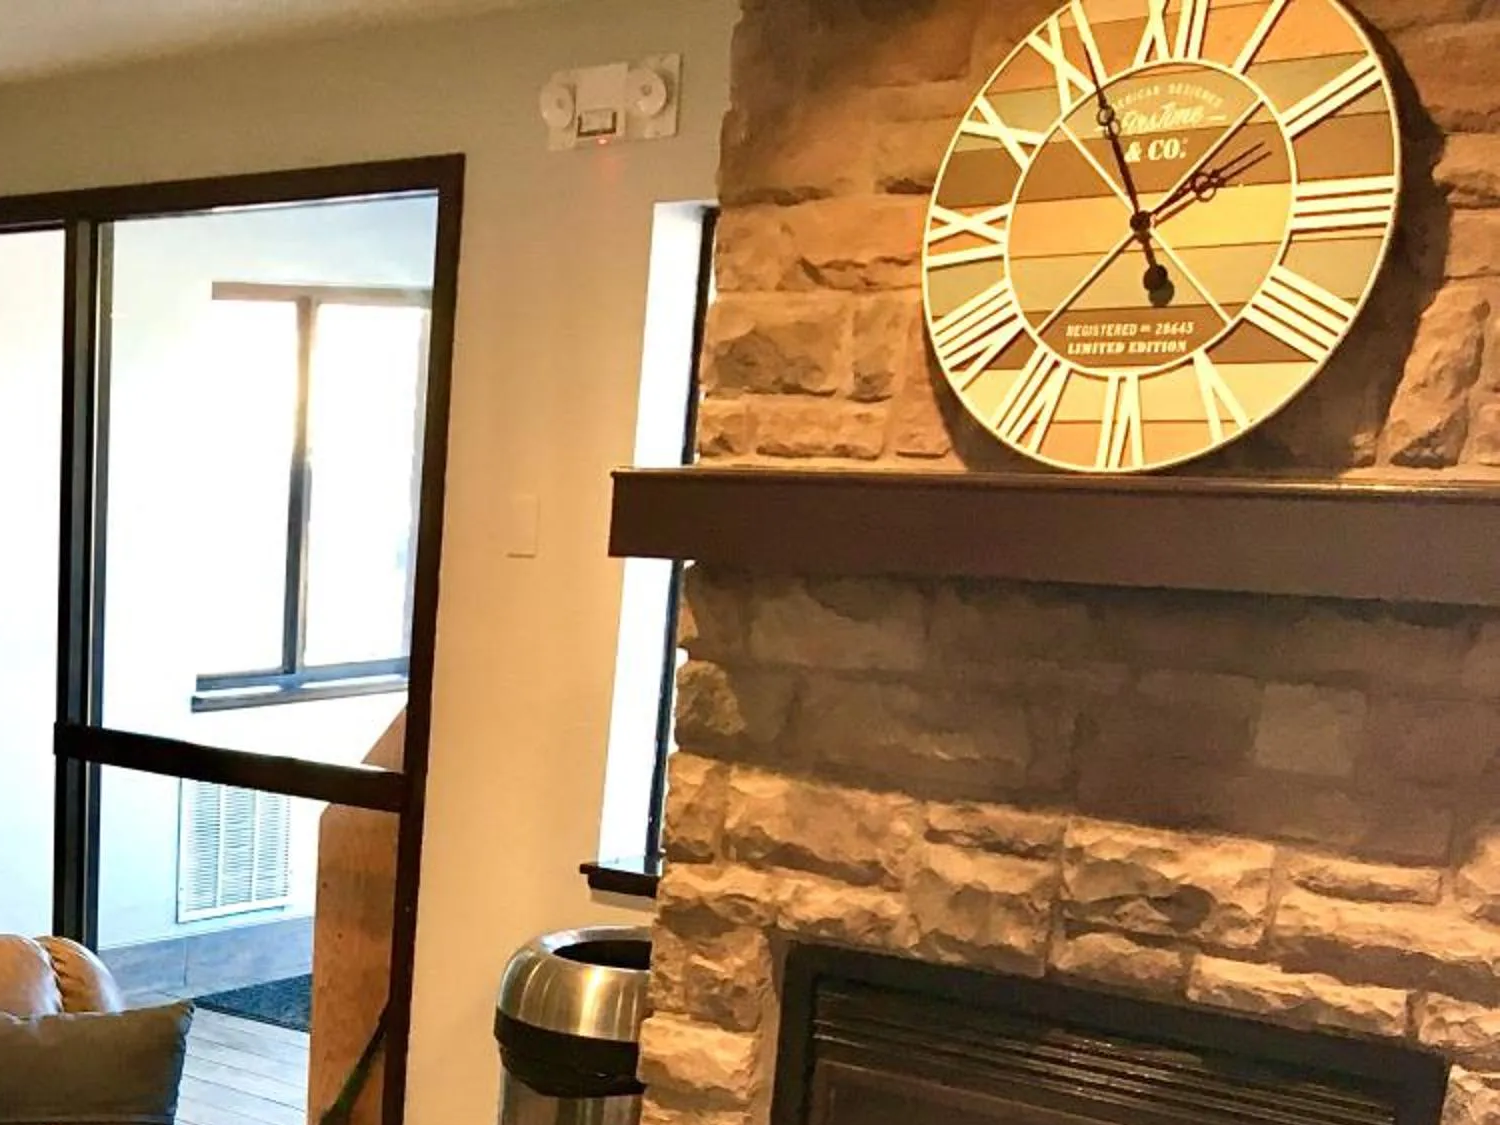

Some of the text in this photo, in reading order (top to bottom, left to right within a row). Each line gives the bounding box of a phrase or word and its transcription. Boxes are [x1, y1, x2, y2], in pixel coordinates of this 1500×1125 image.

[959, 94, 1047, 173] X
[1279, 53, 1382, 141] II
[1124, 141, 1141, 163] &
[925, 203, 1014, 270] IX
[1290, 175, 1396, 231] III
[931, 276, 1027, 392] VIII
[1067, 340, 1187, 355] LIMITED EDITION
[1243, 265, 1357, 362] IIII
[992, 343, 1072, 454] VII
[1095, 372, 1145, 470] VI
[1192, 349, 1249, 445] V
